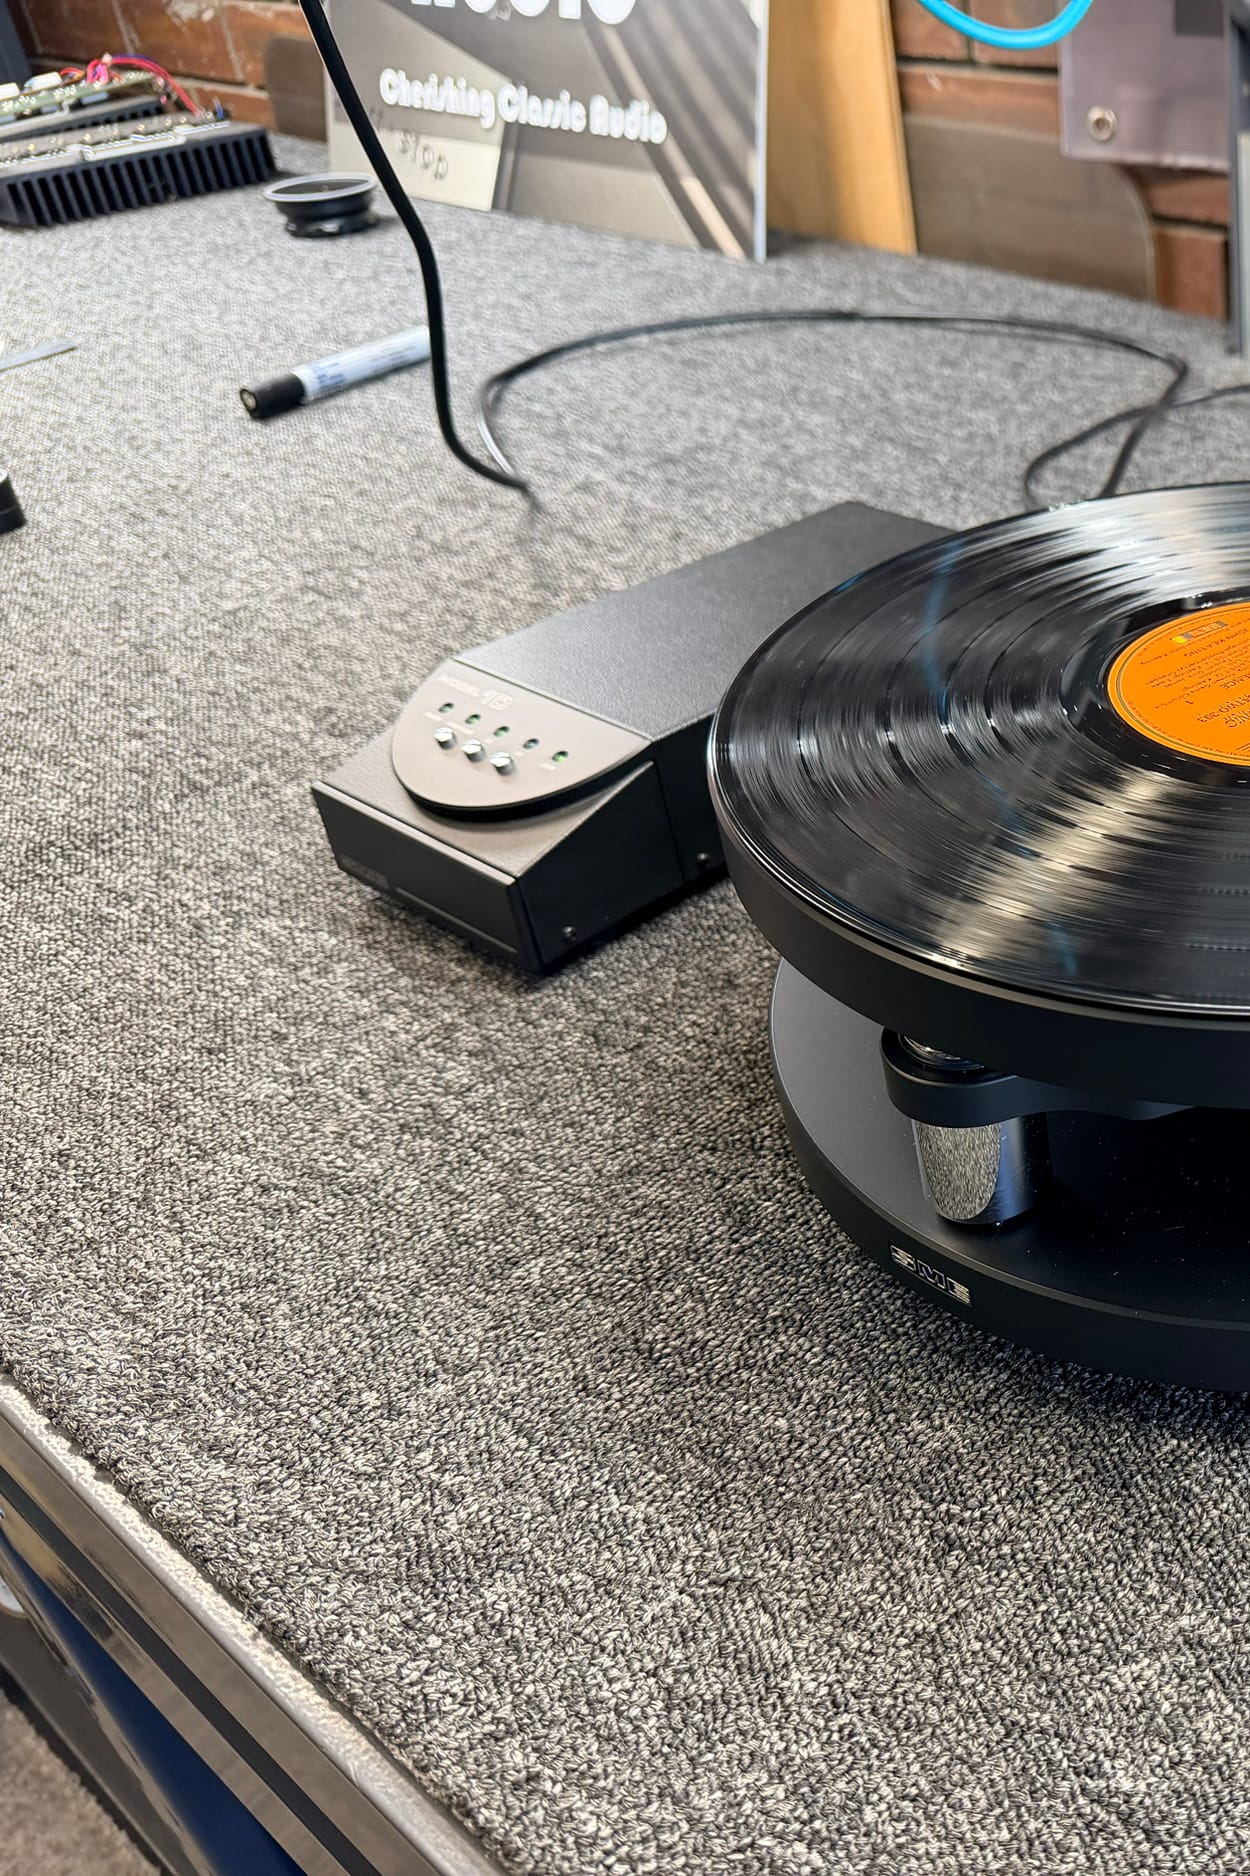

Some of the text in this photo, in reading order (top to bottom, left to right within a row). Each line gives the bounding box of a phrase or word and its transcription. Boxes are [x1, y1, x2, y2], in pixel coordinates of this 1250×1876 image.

[379, 68, 495, 128] Cherishing
[499, 81, 587, 133] Classic
[590, 96, 667, 144] Audio
[890, 1245, 971, 1303] SME
